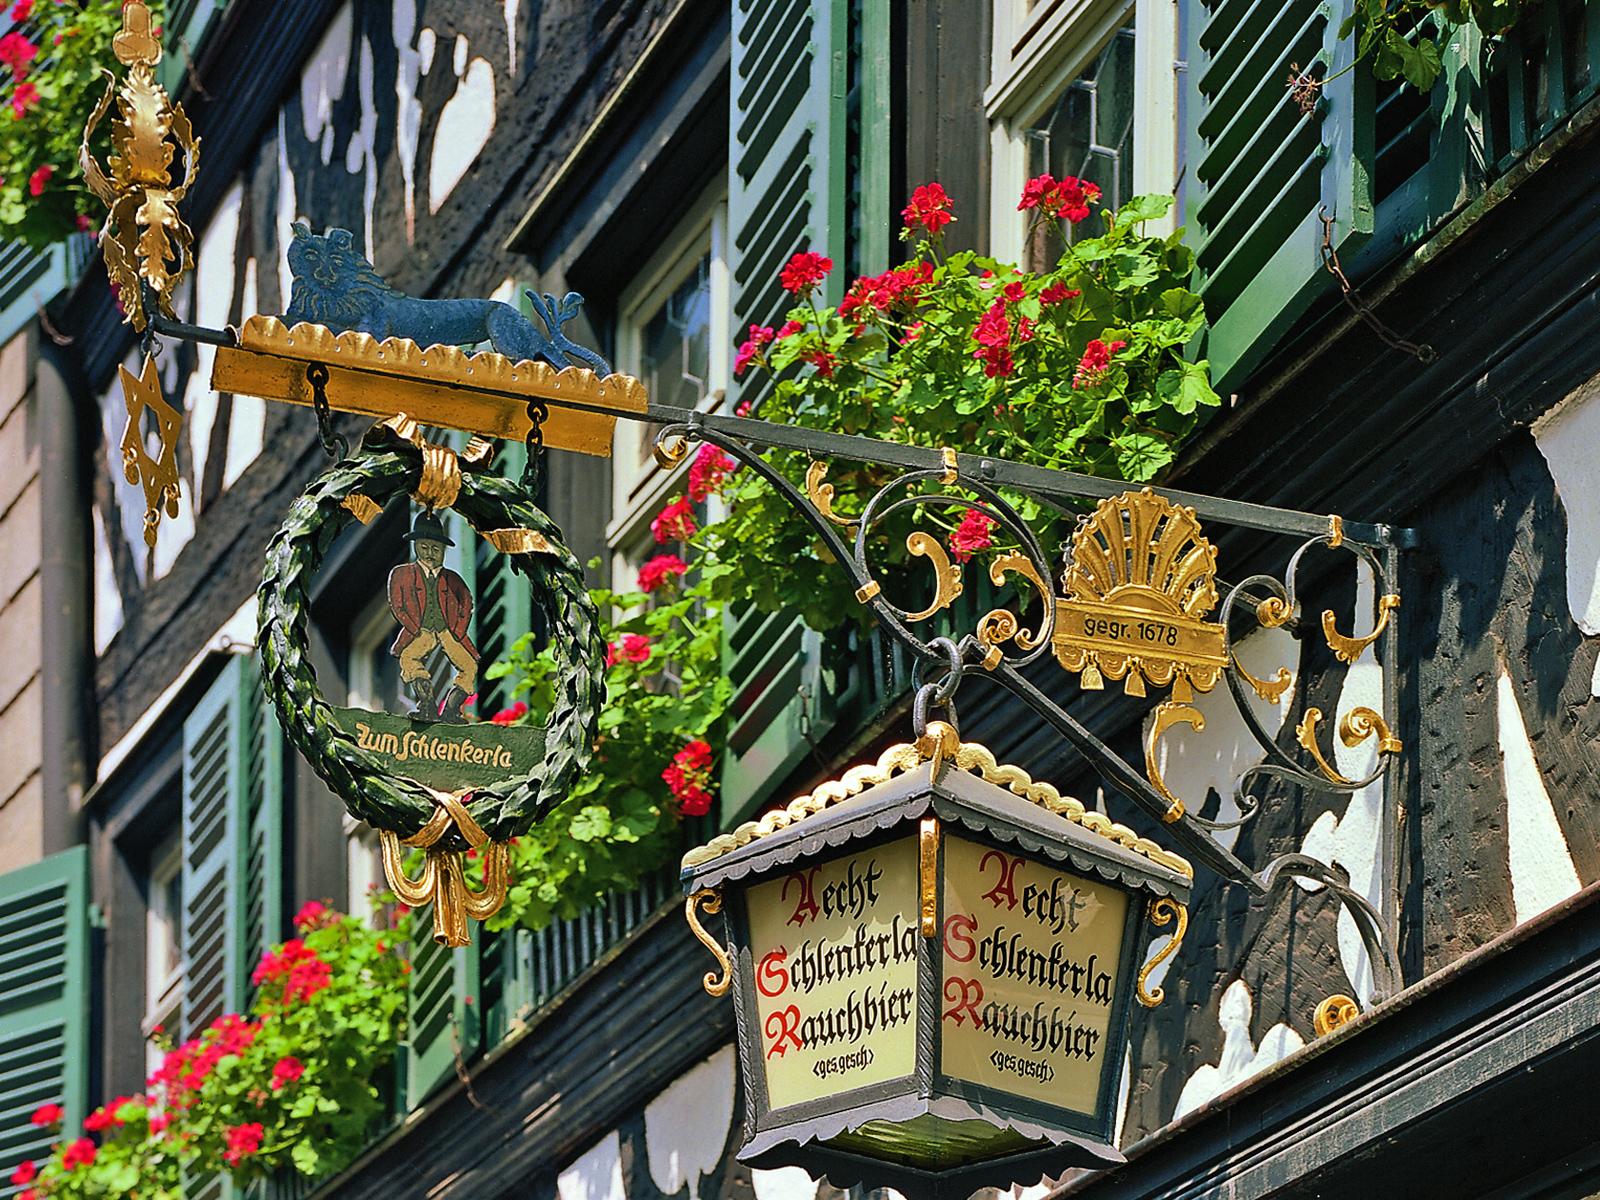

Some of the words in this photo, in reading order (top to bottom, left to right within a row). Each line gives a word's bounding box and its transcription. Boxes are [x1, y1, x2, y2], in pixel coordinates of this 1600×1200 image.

[1084, 617, 1131, 640] gegr.
[1137, 623, 1178, 646] 1678
[355, 722, 397, 754] Zum
[396, 731, 512, 767] Schlenkerla
[782, 860, 884, 927] Aecht
[979, 851, 1085, 932] Aecht
[756, 915, 918, 998] Schlenkerla
[943, 913, 1113, 1006] Schlenkerla
[766, 980, 914, 1060] Rauchbier
[942, 976, 1100, 1061] Rauchbier
